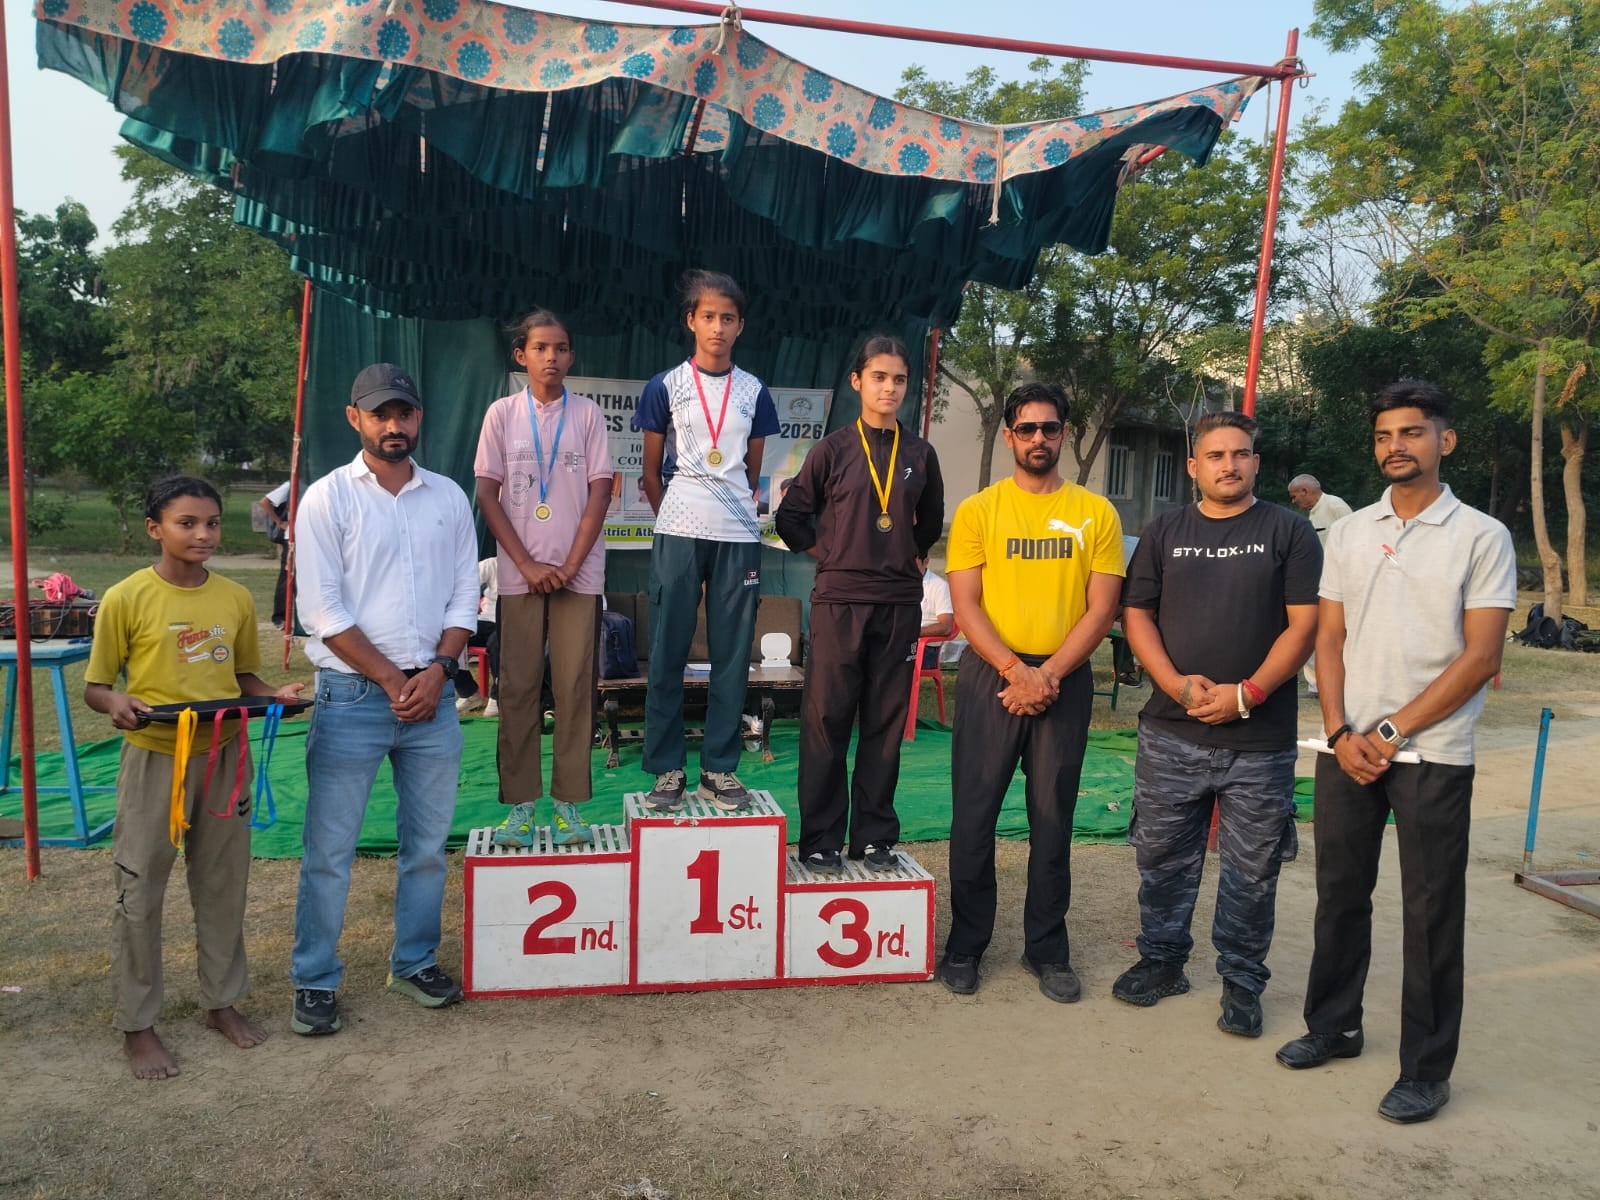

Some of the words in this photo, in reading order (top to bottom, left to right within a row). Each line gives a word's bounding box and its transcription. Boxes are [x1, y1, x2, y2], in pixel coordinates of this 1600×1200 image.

[780, 423, 823, 440] 2026
[1006, 537, 1073, 560] PUMA
[522, 880, 619, 956] 2nd.
[686, 849, 763, 935] 1st.
[816, 897, 910, 969] 3rd.
